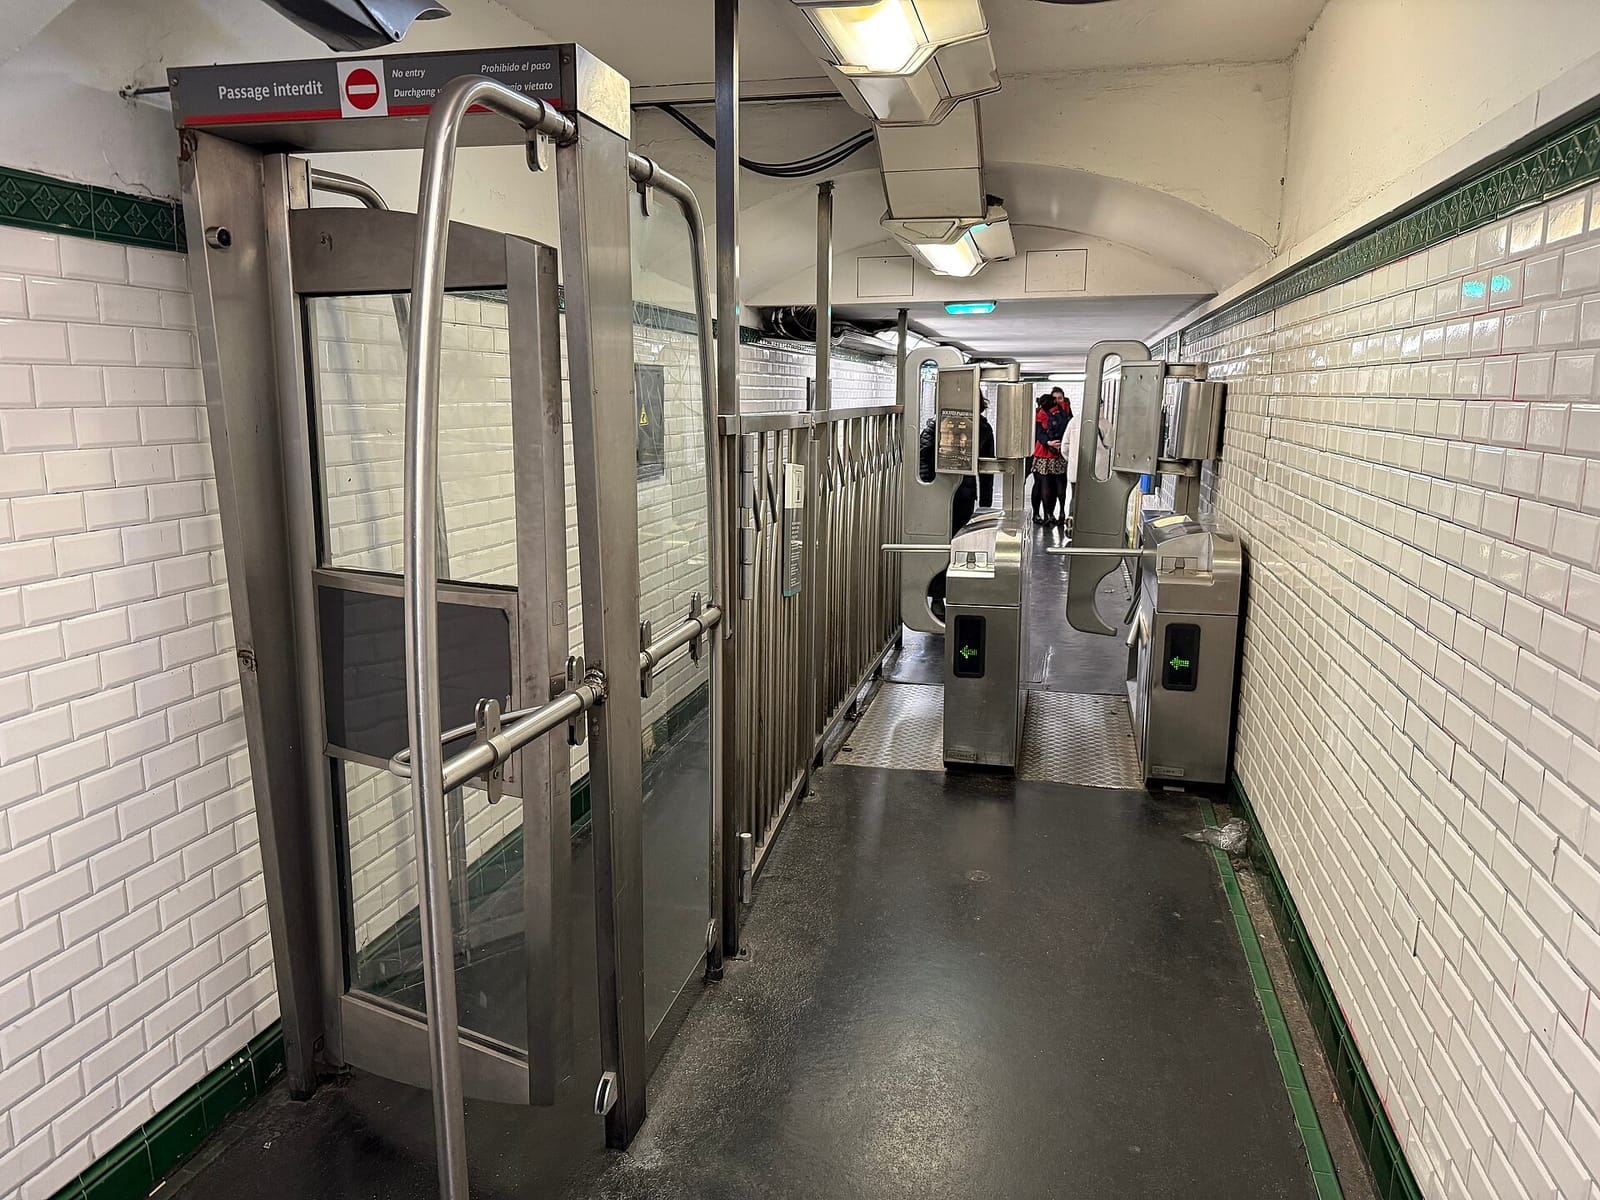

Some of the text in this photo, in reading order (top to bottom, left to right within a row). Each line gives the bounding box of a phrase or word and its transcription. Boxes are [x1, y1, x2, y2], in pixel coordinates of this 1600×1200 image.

[481, 61, 551, 73] Prohibido el paso
[391, 69, 426, 79] No entry
[217, 80, 323, 101] Passage interdit
[524, 81, 553, 92] vietato
[393, 87, 436, 98] Durchgang
